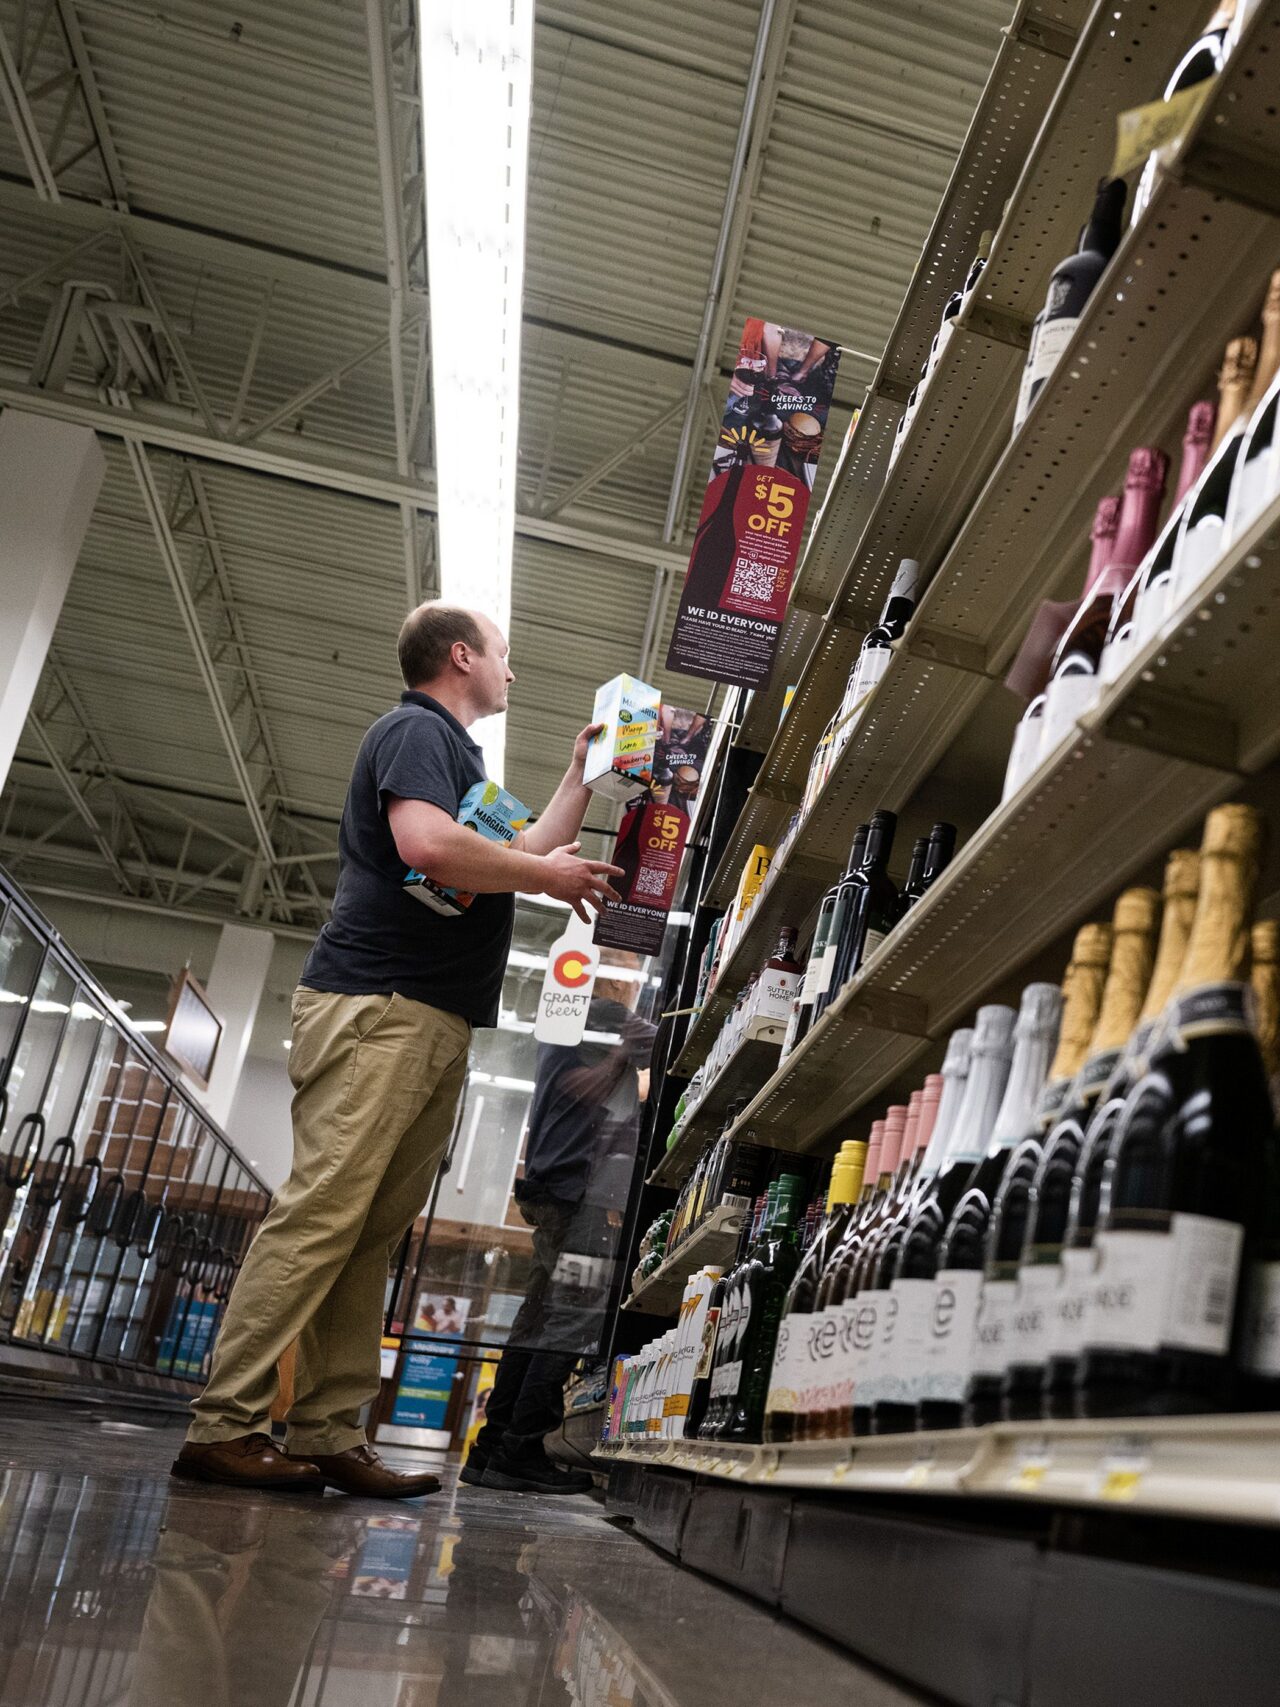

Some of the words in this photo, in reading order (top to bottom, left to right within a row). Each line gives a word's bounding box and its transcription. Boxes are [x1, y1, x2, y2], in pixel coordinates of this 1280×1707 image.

[771, 395, 803, 403] CHEERS
[755, 483, 795, 518] $5
[748, 514, 792, 536] OFF
[688, 606, 705, 617] WE
[707, 611, 718, 620] ID
[720, 614, 778, 634] EVERYONE
[473, 808, 514, 842] MARGARITA
[653, 815, 680, 839] $5
[648, 837, 678, 852] OFF
[607, 900, 619, 908] WE
[628, 905, 666, 918] EVERYONE
[543, 992, 589, 1005] CRAFT
[767, 986, 794, 996] SUTTER
[769, 993, 790, 1001] HOME
[545, 1000, 582, 1018] beer
